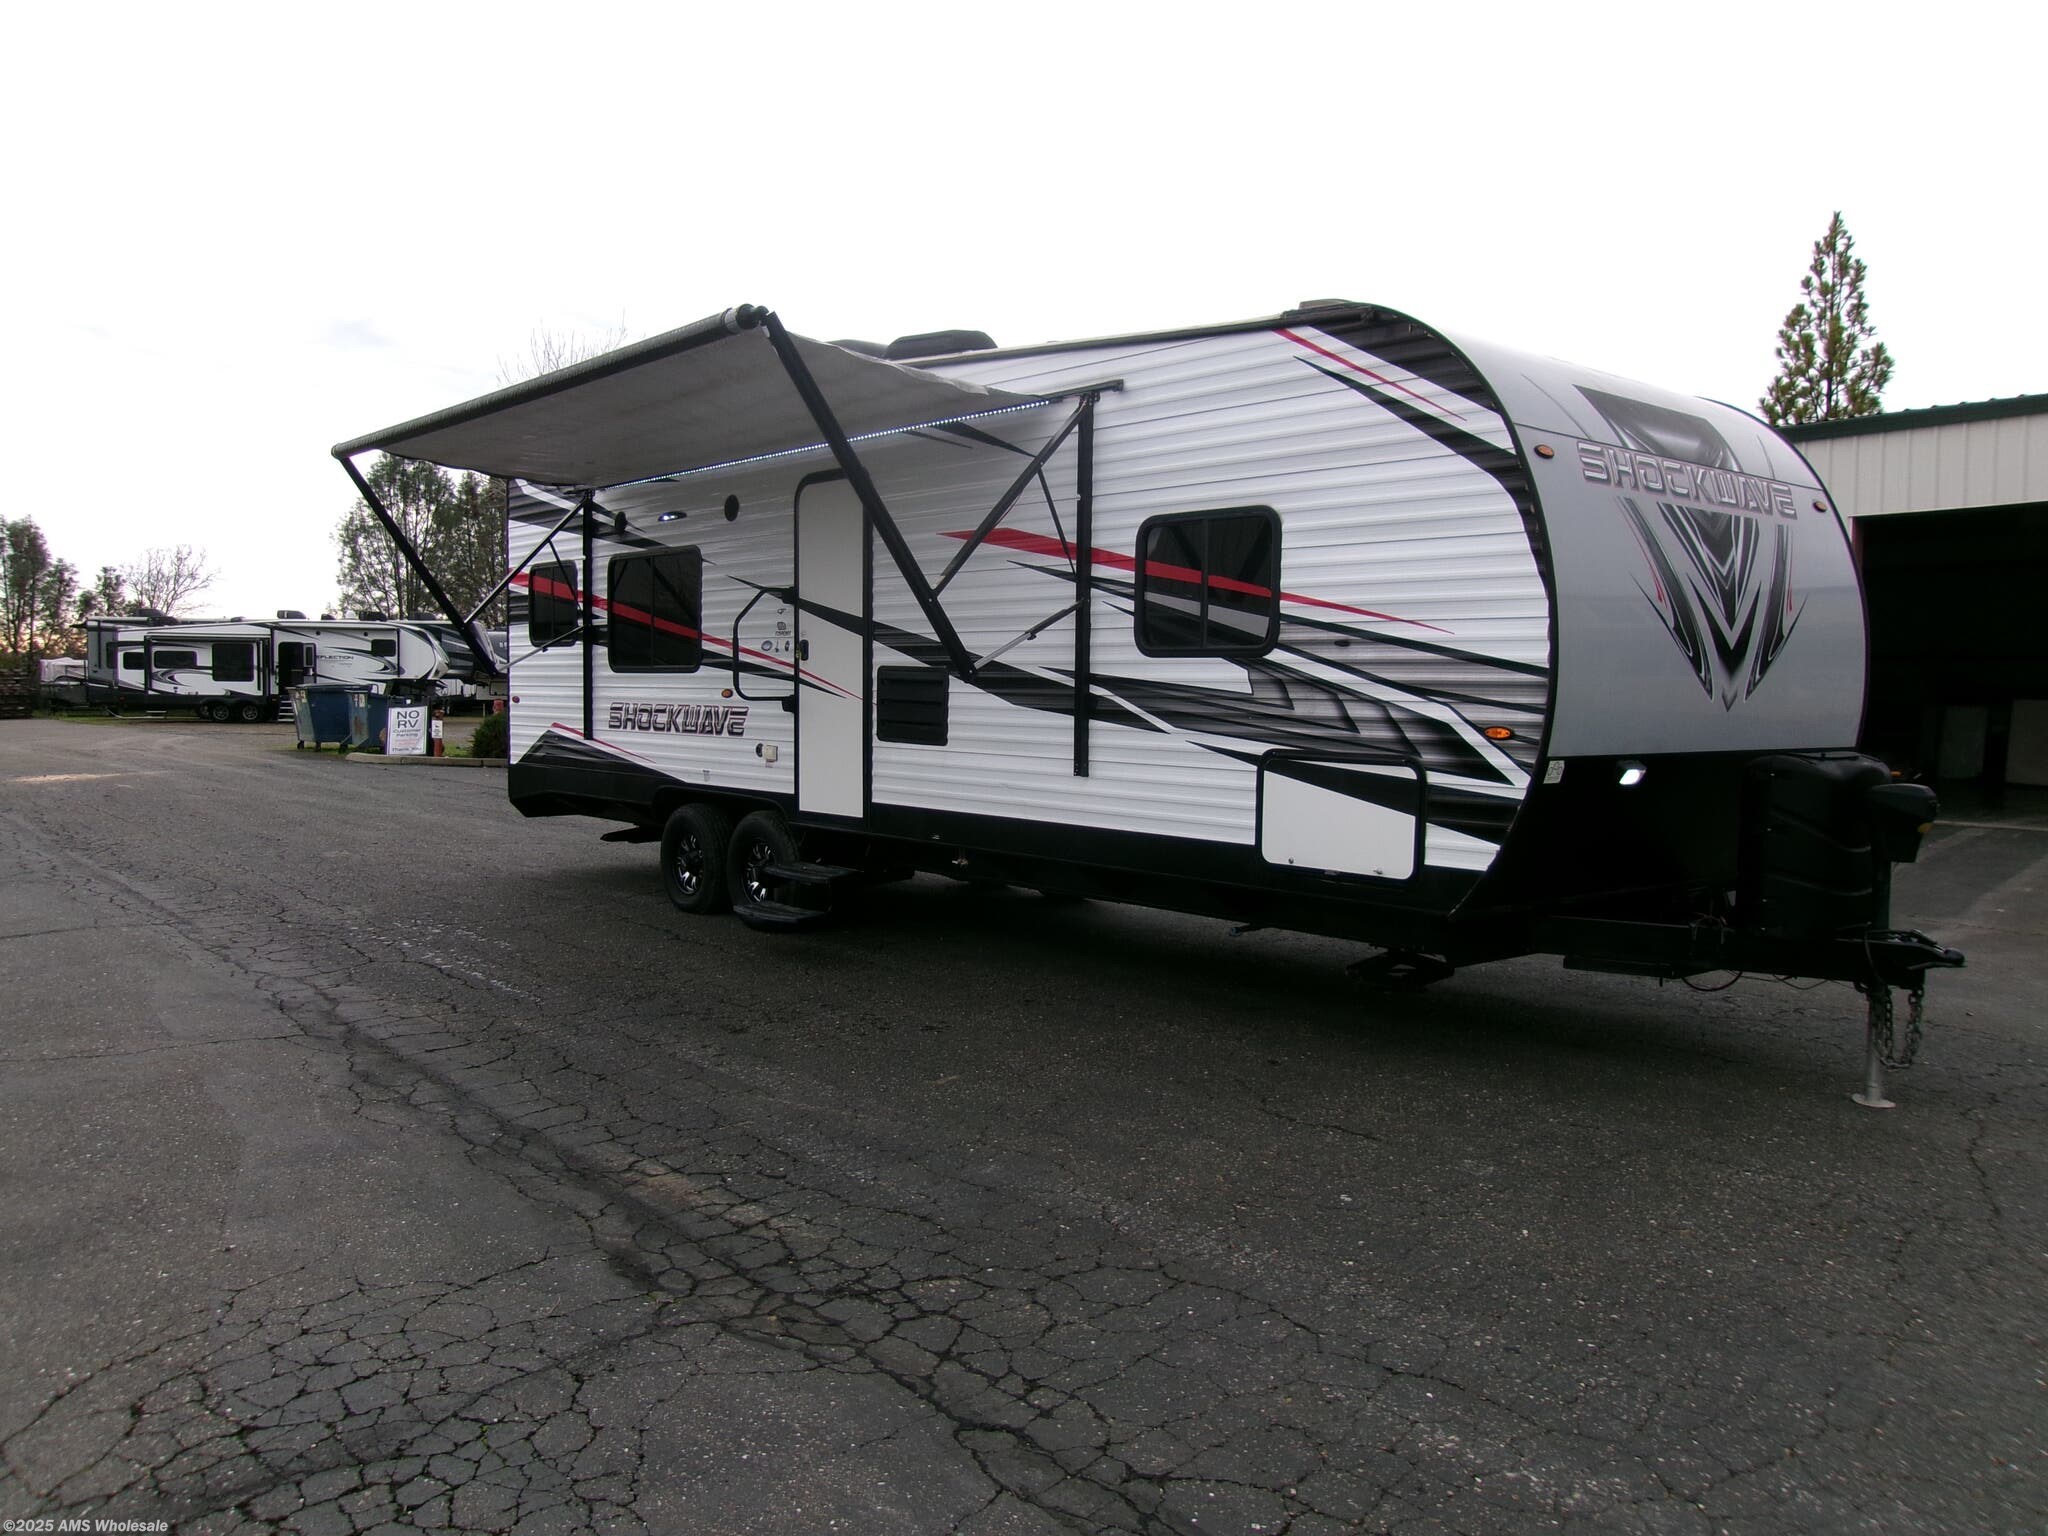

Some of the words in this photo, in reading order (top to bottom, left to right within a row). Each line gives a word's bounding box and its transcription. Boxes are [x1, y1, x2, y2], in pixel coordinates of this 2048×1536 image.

[1577, 441, 1798, 520] SHOCKWAVE
[397, 710, 420, 719] NO
[397, 719, 419, 729] RV
[608, 702, 749, 737] SHOCKWAVE
